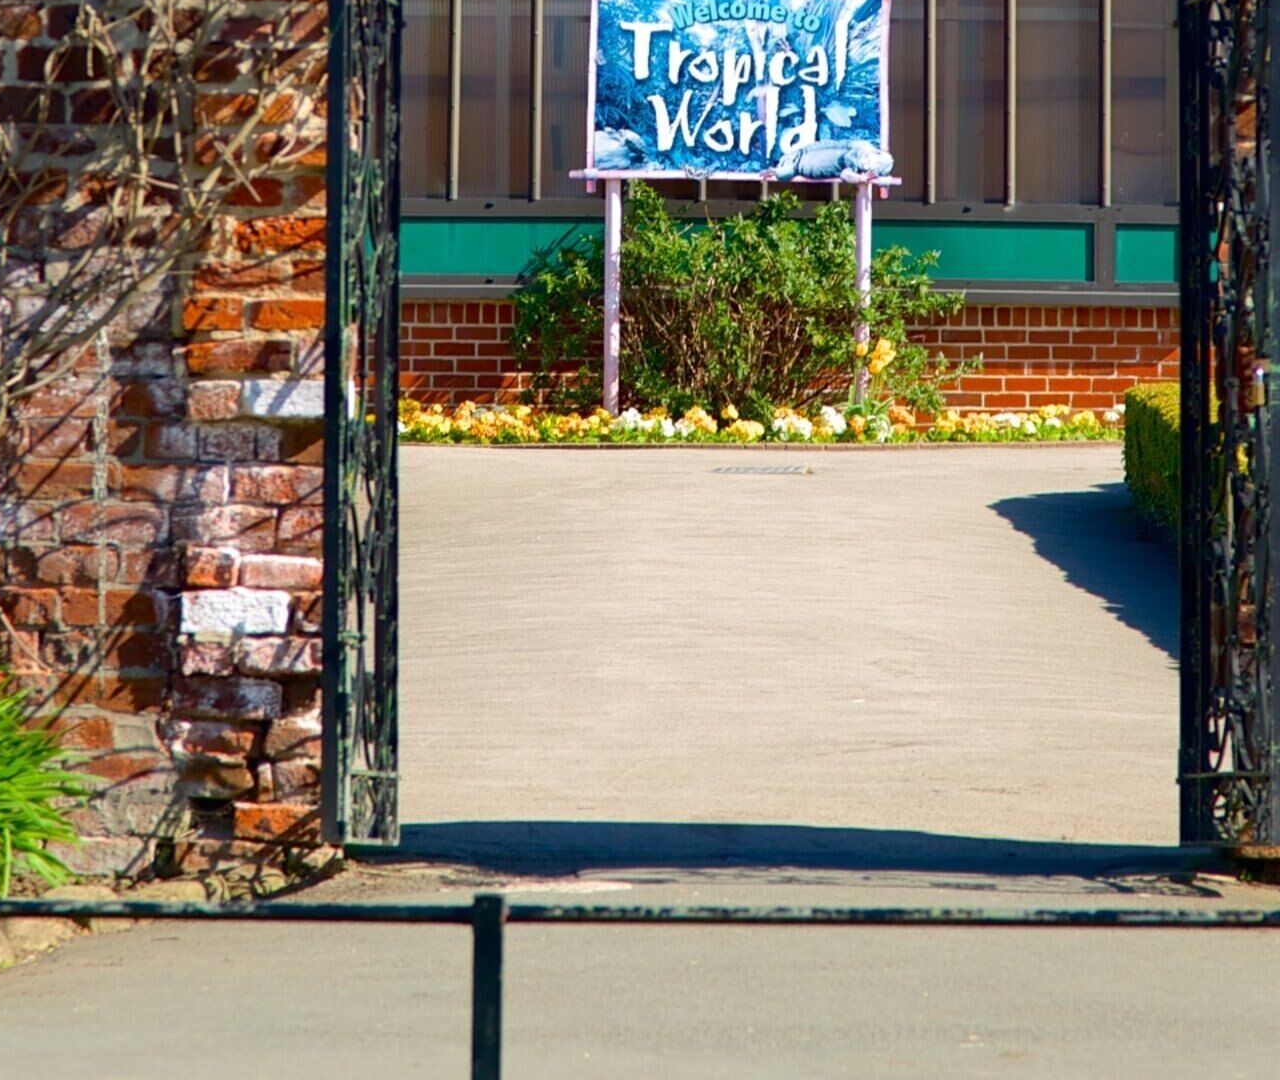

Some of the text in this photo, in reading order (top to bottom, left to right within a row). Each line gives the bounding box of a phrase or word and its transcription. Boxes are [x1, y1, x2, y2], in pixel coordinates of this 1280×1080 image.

[793, 9, 821, 33] to
[620, 16, 850, 106] Tropical
[647, 82, 818, 160] World
